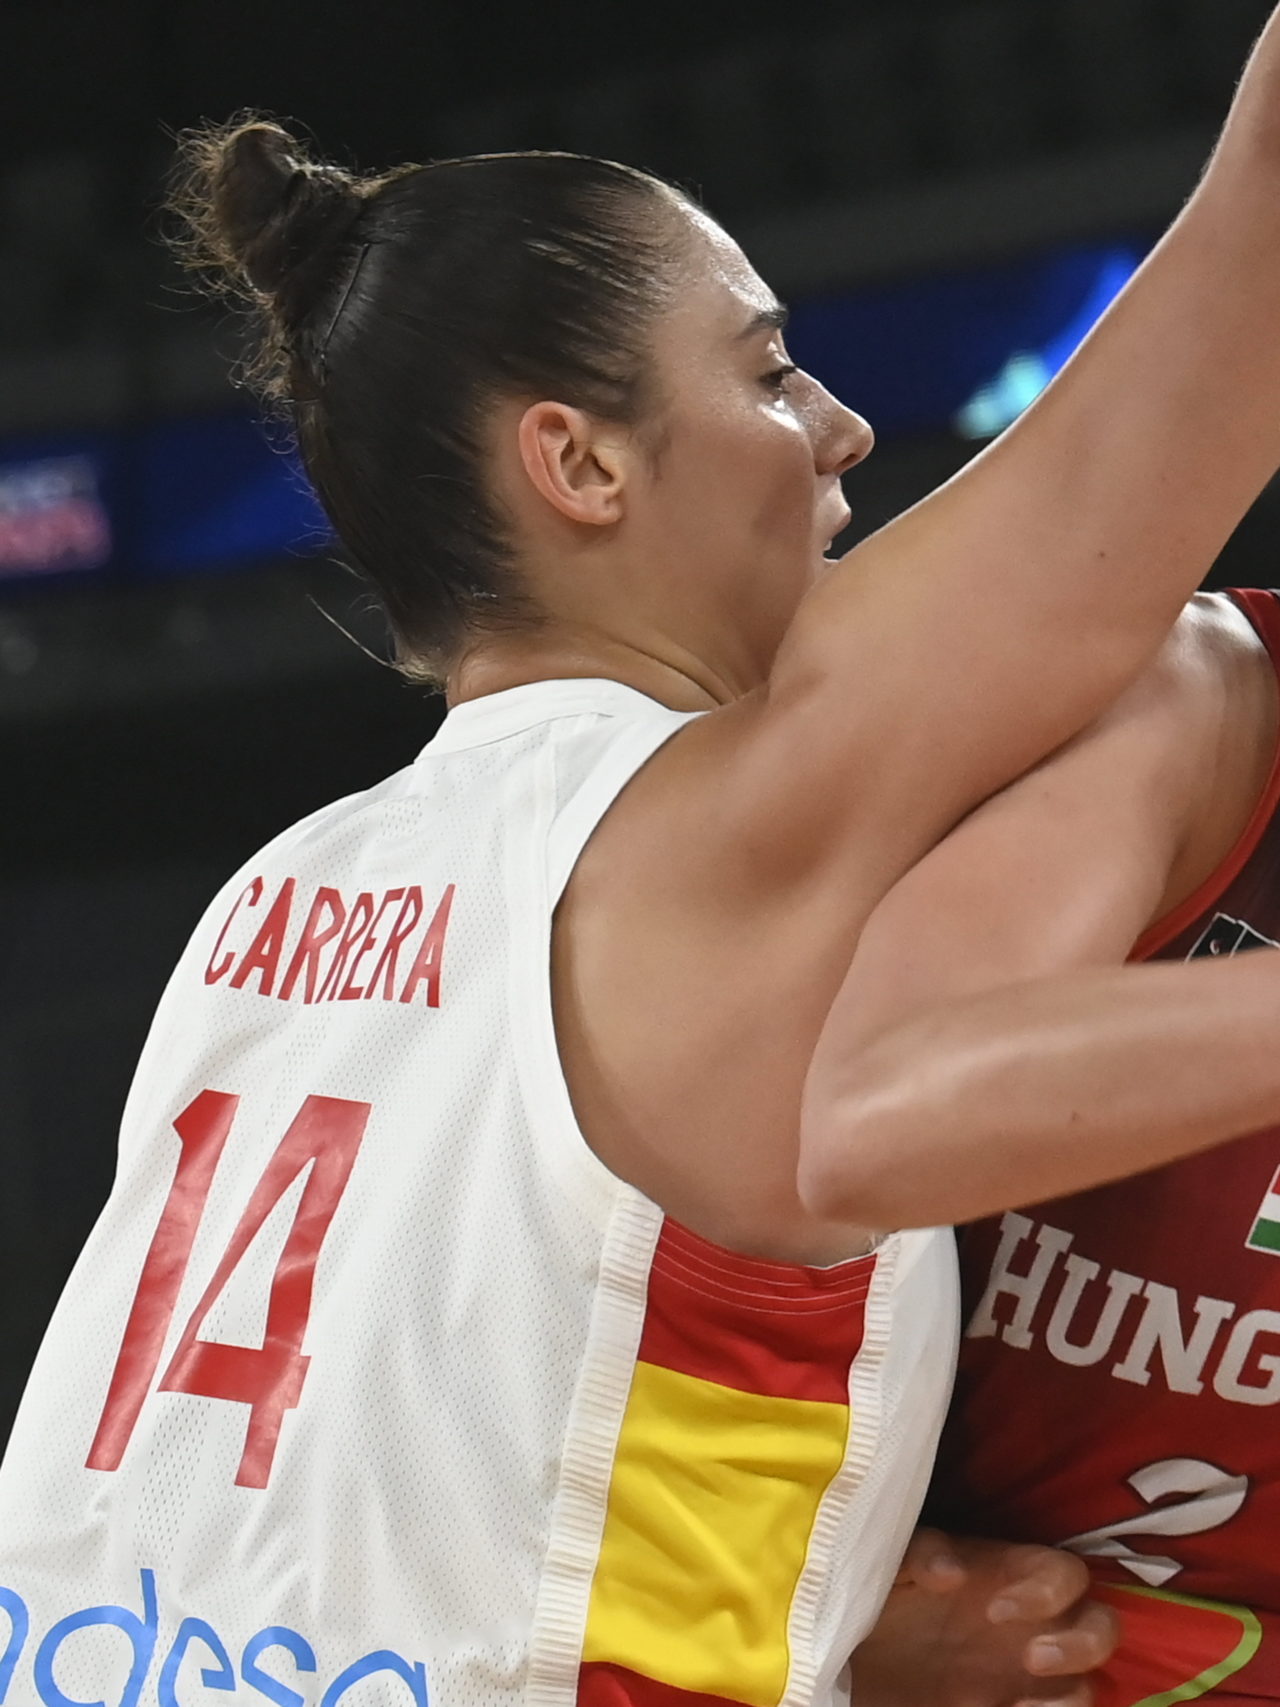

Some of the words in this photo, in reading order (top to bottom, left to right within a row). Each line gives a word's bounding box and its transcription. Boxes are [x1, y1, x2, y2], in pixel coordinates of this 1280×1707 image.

[205, 875, 456, 1008] CARRERA
[84, 1088, 372, 1489] 14
[1053, 1457, 1249, 1587] 2
